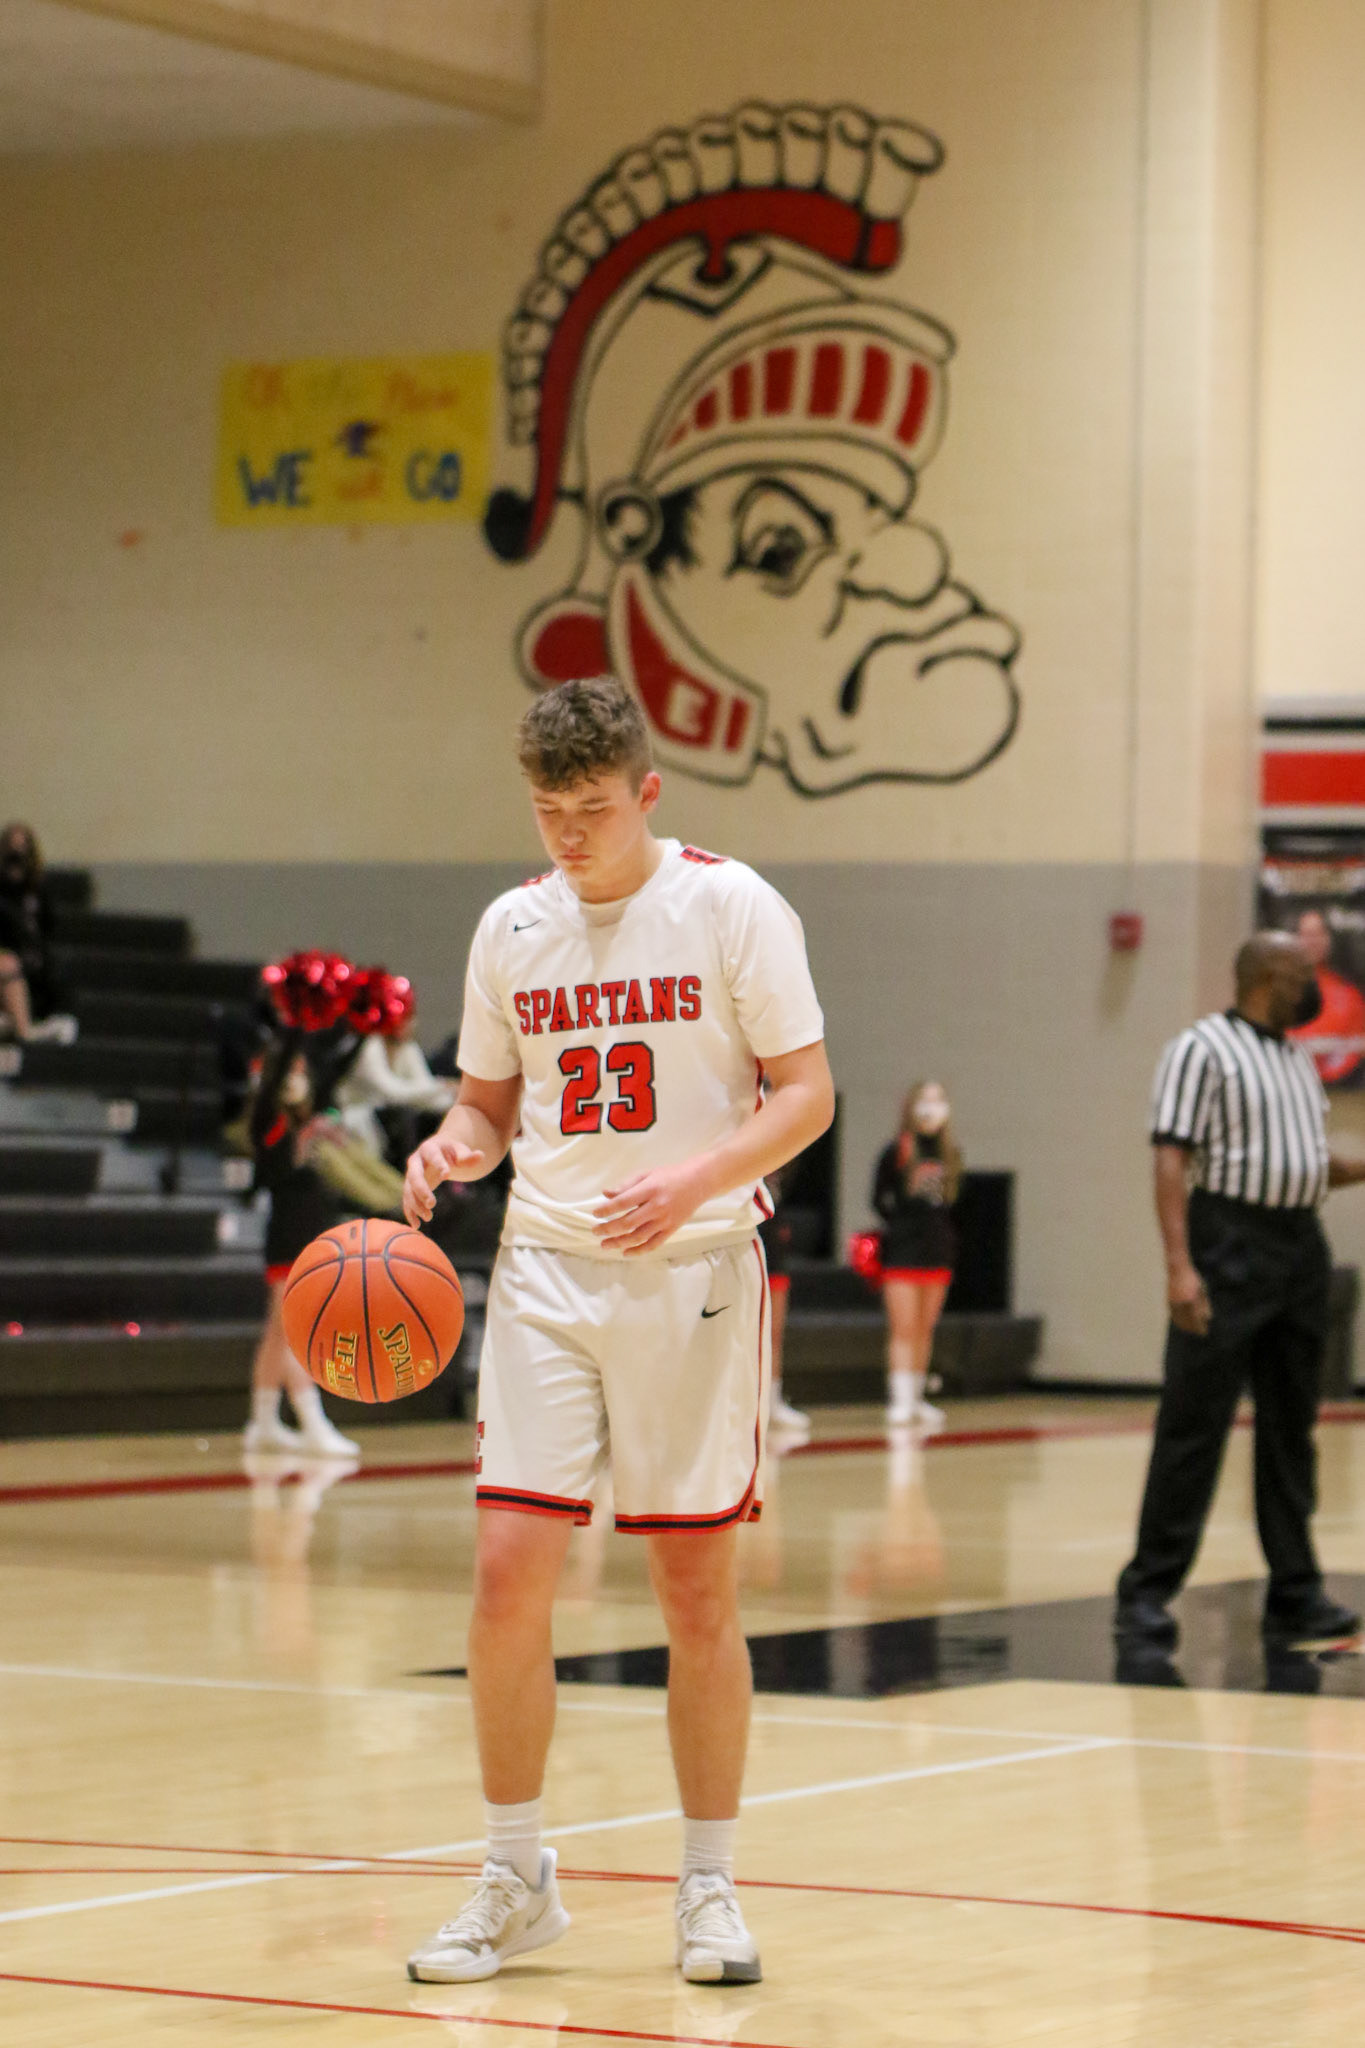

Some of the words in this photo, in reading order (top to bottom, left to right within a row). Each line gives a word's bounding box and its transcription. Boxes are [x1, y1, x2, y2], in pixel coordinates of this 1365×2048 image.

[237, 449, 312, 508] WE
[405, 449, 461, 502] GO
[513, 975, 702, 1036] SPARTANS
[557, 1041, 657, 1136] 23
